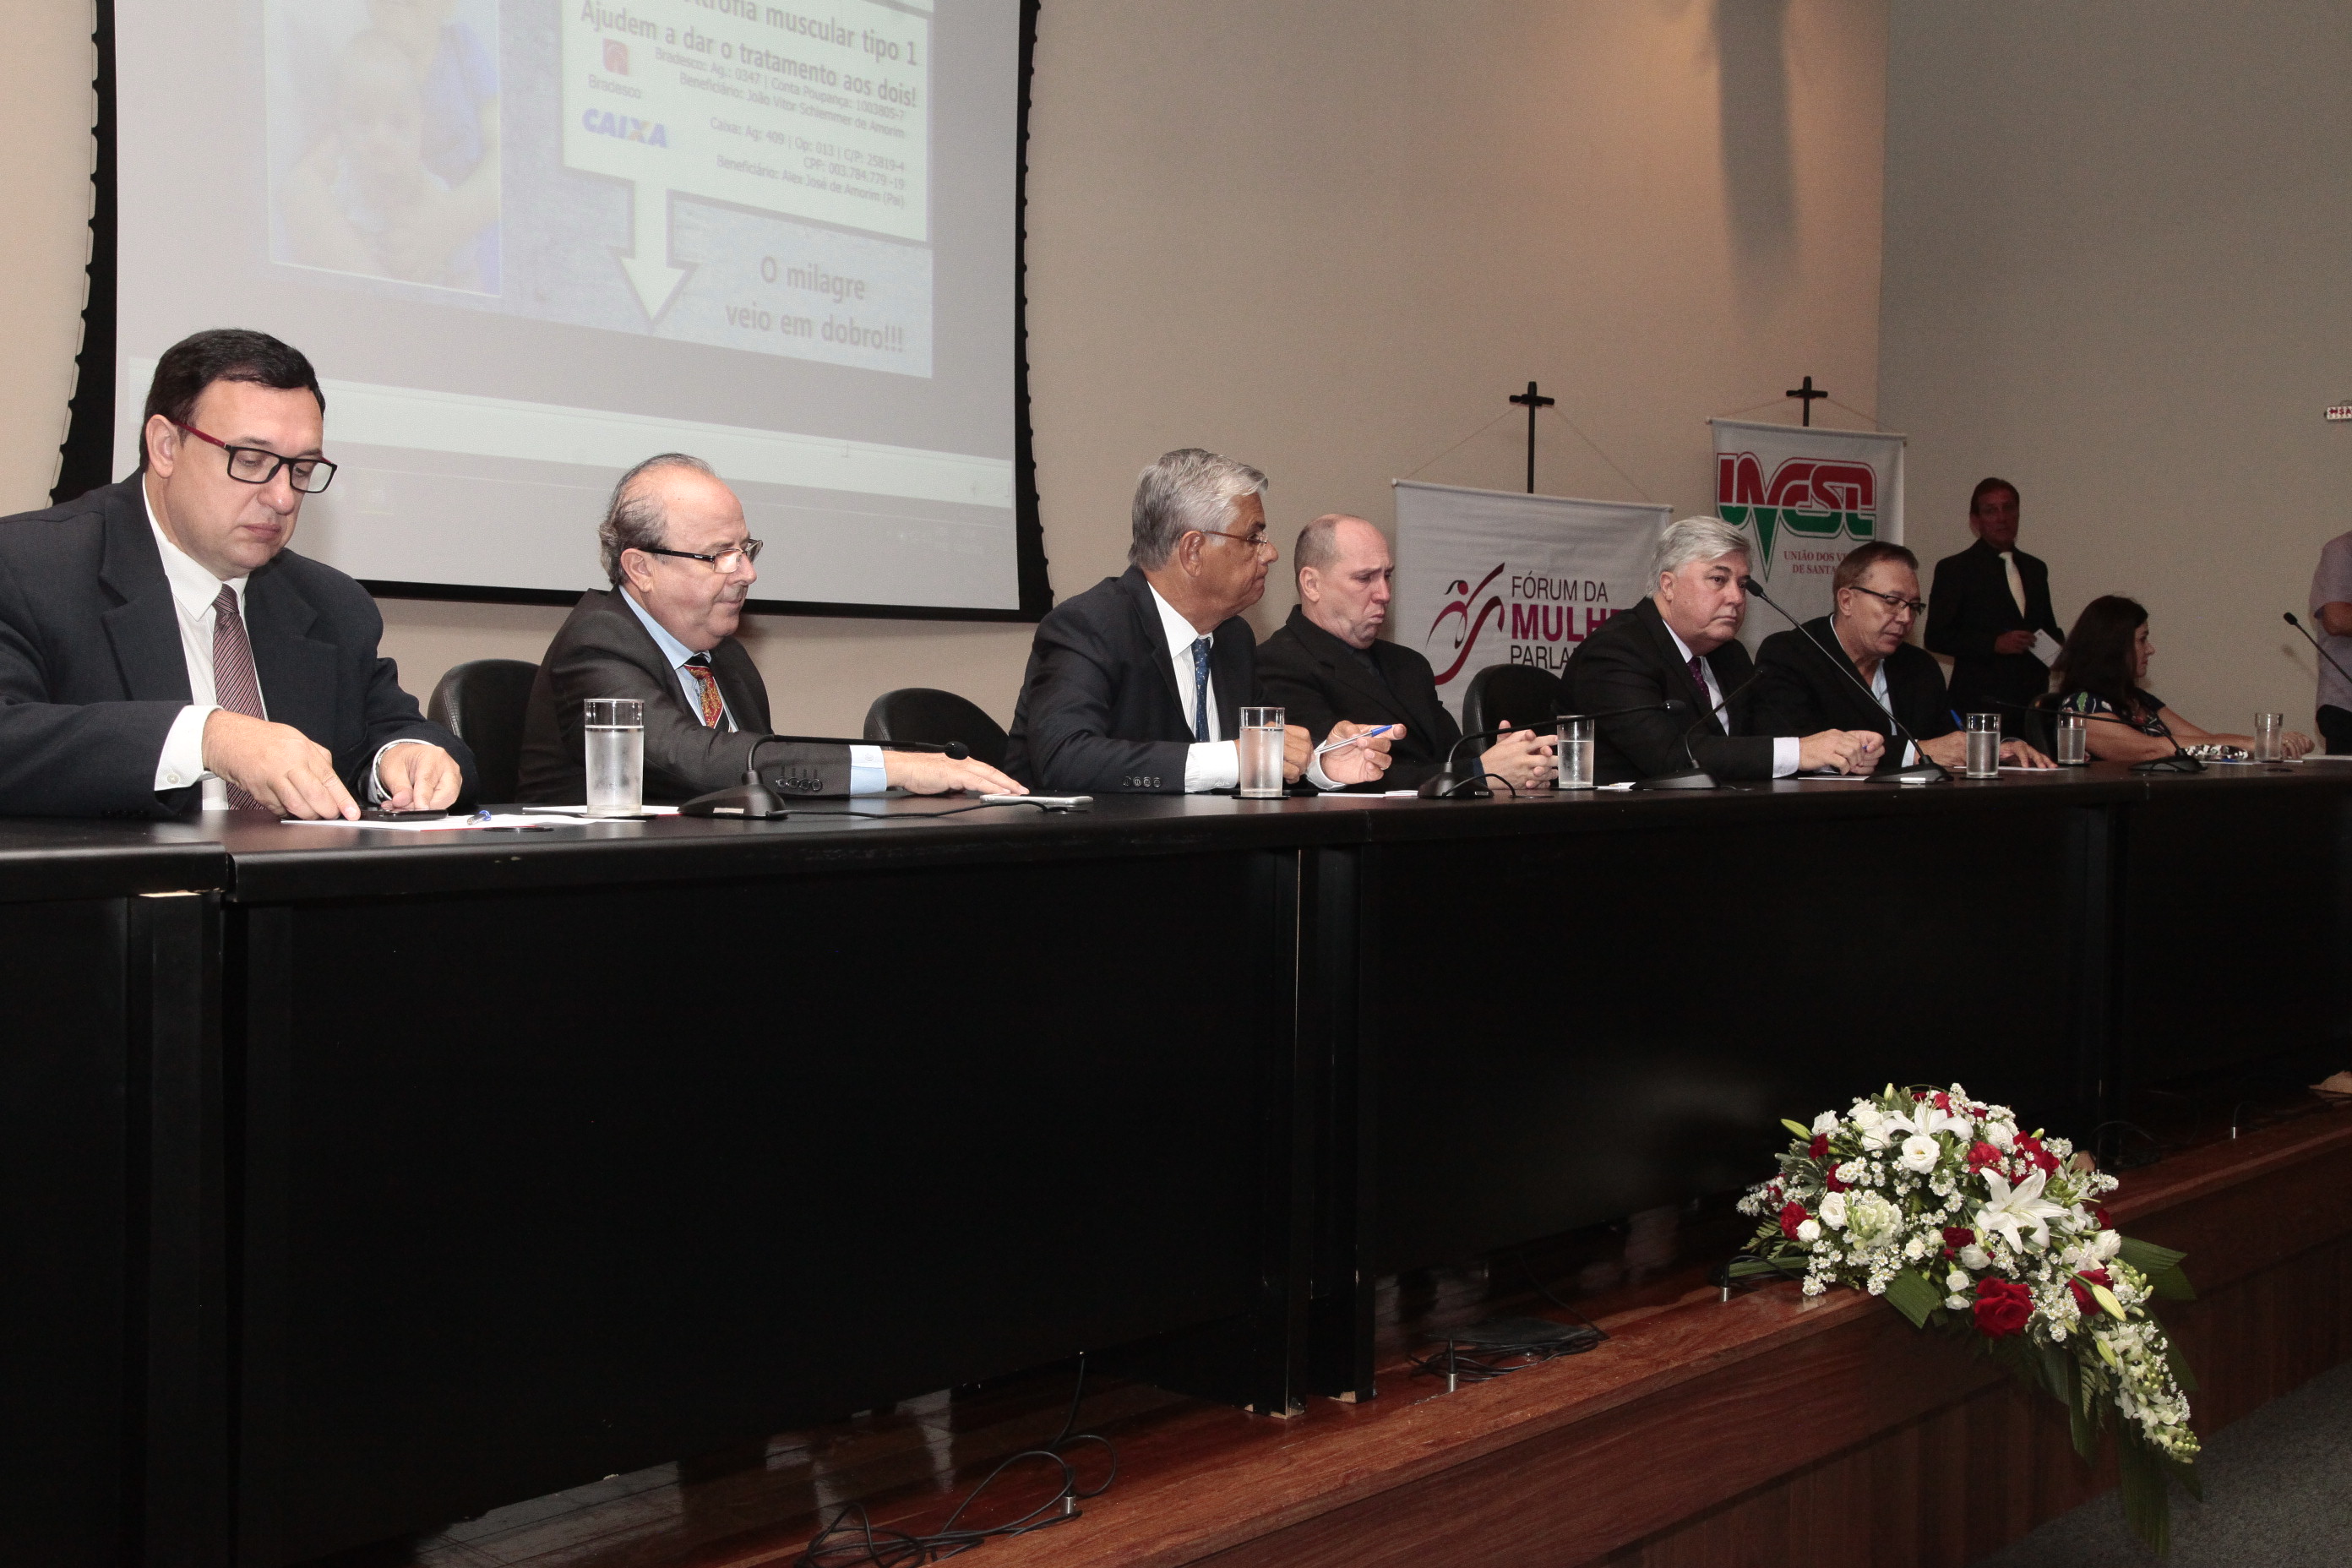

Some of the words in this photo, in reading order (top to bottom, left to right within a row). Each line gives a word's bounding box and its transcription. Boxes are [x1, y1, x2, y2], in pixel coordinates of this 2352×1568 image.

[684, 0, 757, 21] ofia
[766, 8, 854, 48] muscular
[863, 29, 899, 63] tipo
[906, 41, 917, 66] 1
[580, 0, 657, 41] Ajudem
[665, 27, 675, 45] a
[683, 25, 714, 54] dar
[721, 41, 732, 59] o
[739, 43, 836, 86] tratamento
[843, 74, 871, 95] aos
[878, 78, 917, 107] dois!
[588, 74, 642, 100] Bradesco
[771, 77, 800, 95] Conta
[582, 108, 667, 149] CAIXA
[747, 89, 770, 106] João
[854, 117, 867, 129] de
[829, 181, 842, 193] de
[760, 255, 777, 284] O
[787, 263, 866, 304] milagre
[726, 302, 771, 332] veio
[781, 313, 813, 339] em
[821, 314, 904, 353] dobro!!!
[1783, 549, 1814, 562] UNIÃO
[1816, 552, 1835, 562] DOS
[1793, 564, 1805, 574] DE
[1512, 570, 1577, 601] FÓRUM
[1584, 580, 1609, 602] DA
[1512, 603, 1622, 642] MULH
